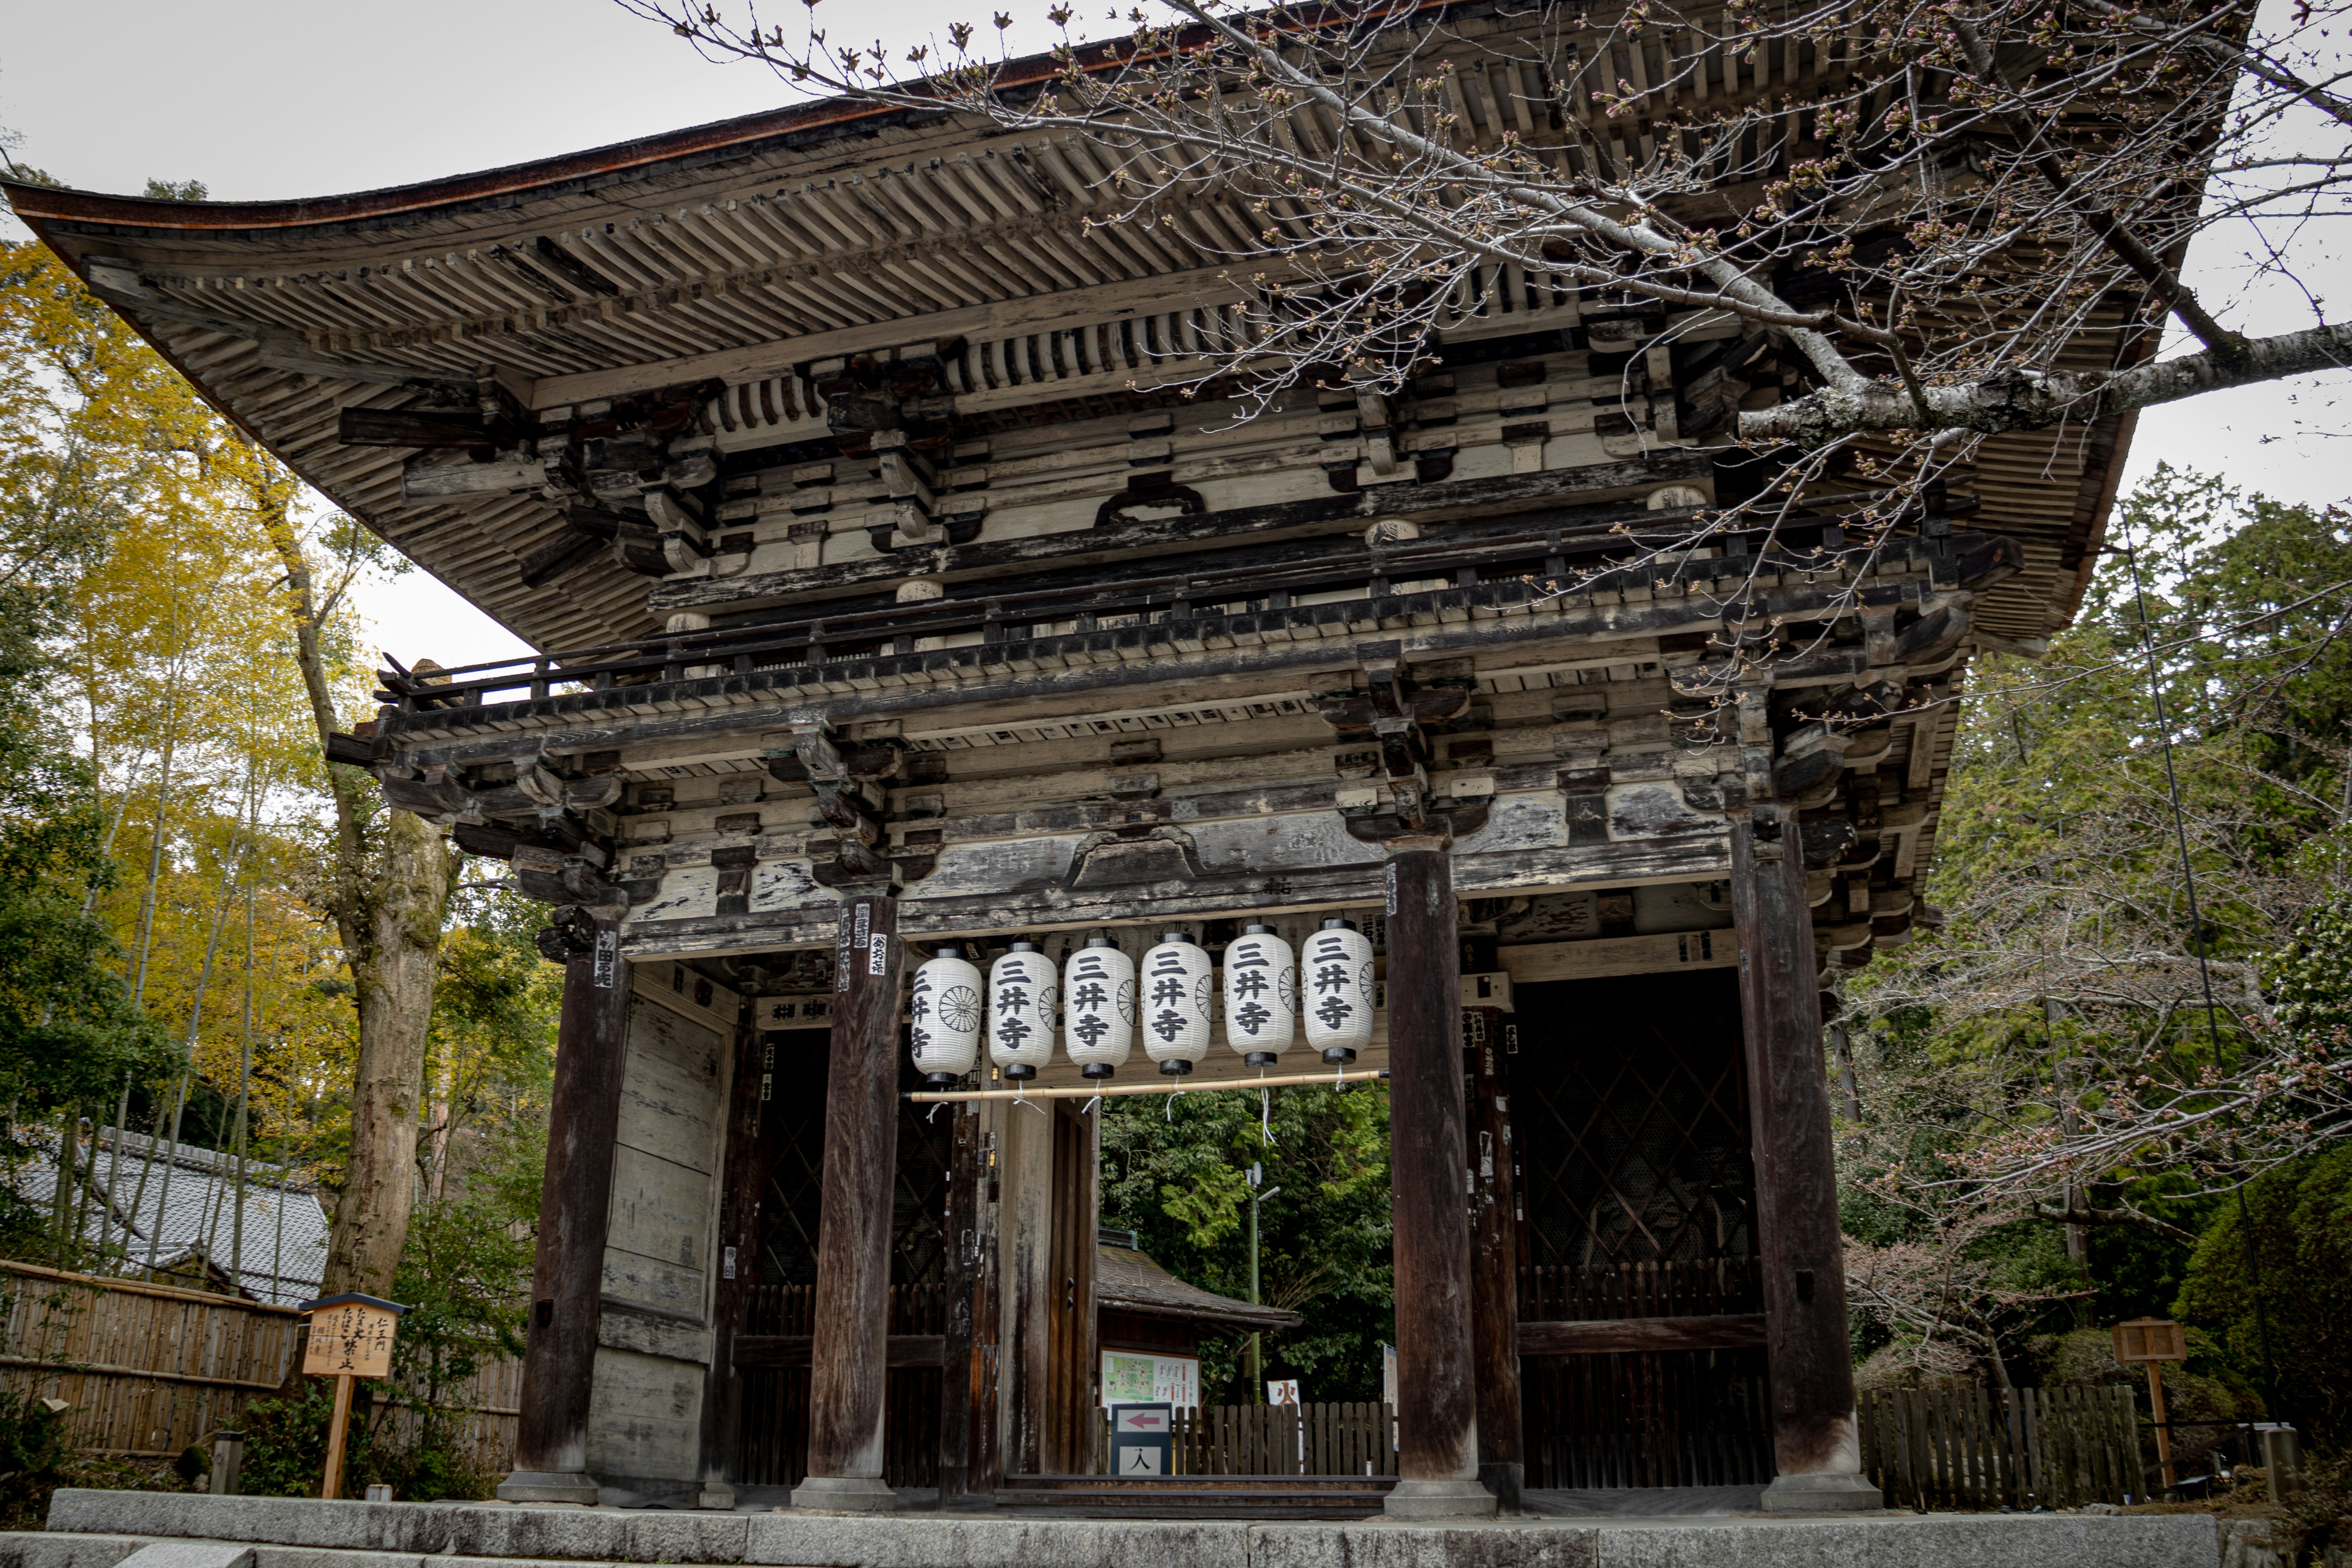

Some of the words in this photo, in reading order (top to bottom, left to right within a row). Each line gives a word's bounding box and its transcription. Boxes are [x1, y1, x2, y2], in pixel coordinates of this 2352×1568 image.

[912, 970, 932, 1058] 三井寺
[997, 961, 1031, 1049] 三井寺
[1073, 956, 1109, 1046] 三井寺
[1150, 951, 1187, 1042] 三井寺
[1233, 943, 1271, 1035] 三井寺
[1313, 937, 1352, 1029] 三井寺
[338, 1338, 357, 1370] 禁止
[341, 1306, 353, 1339] たばこ
[354, 1307, 366, 1339] たき火
[1277, 1381, 1297, 1404] 火
